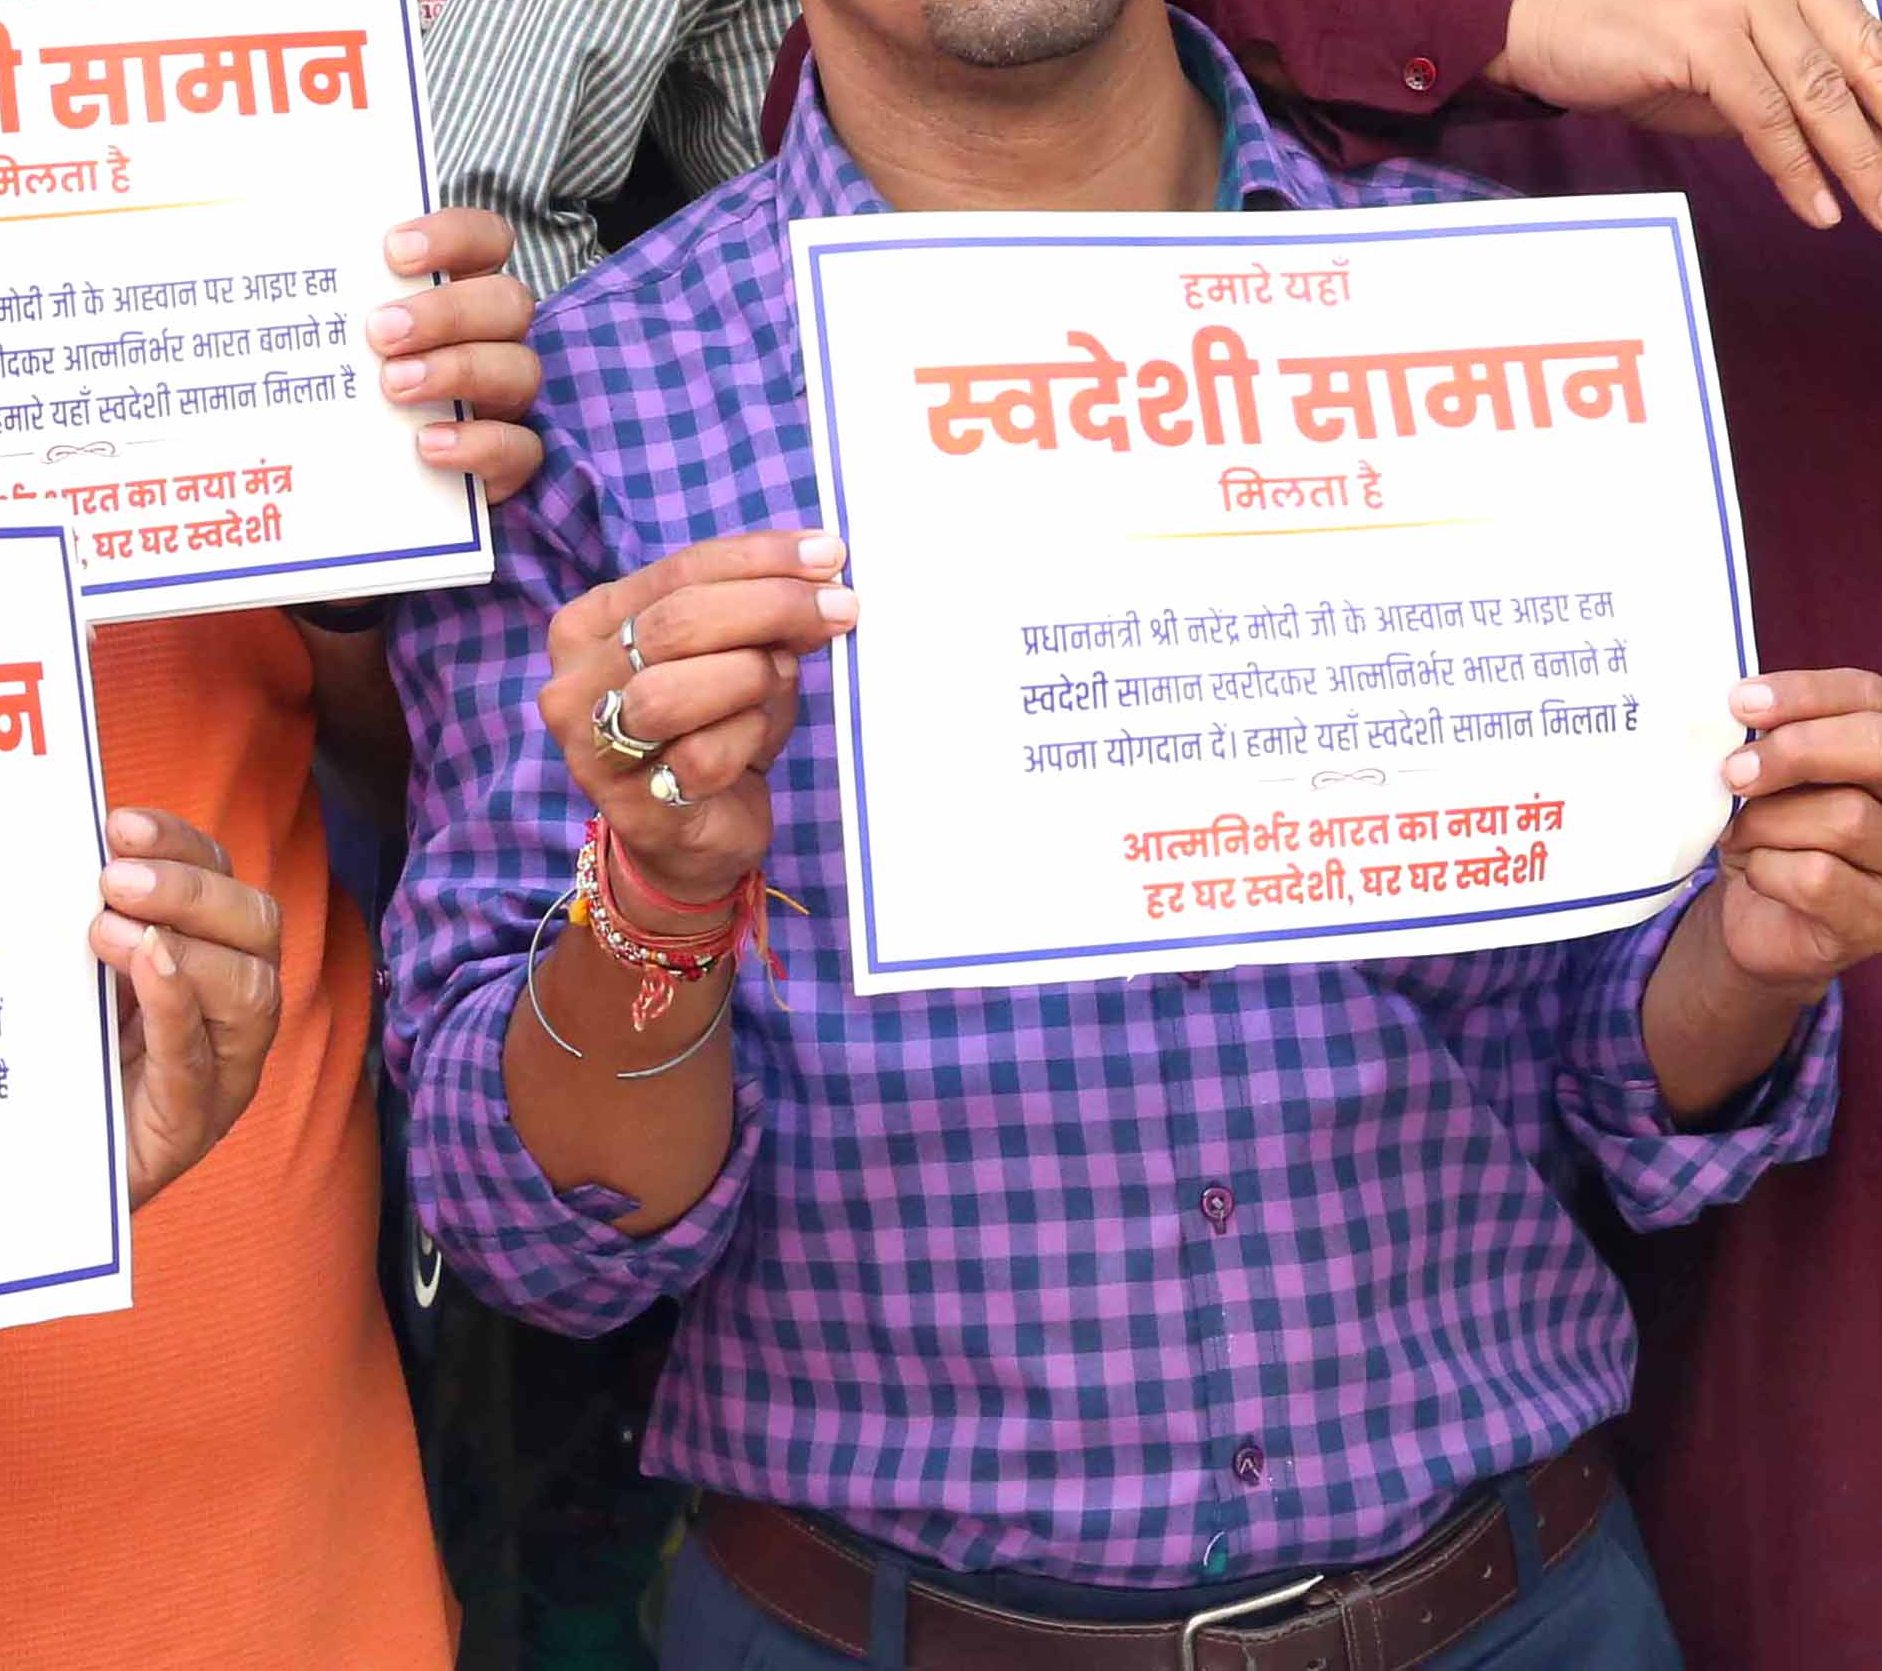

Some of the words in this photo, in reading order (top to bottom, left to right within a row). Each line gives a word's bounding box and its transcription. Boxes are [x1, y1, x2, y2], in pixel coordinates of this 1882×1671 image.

[38, 29, 369, 130] सामान
[106, 144, 131, 194] है
[1179, 262, 1273, 310] हमारे
[1280, 259, 1351, 307] यहाँ
[913, 324, 1263, 456] स्वदेशी
[1276, 338, 1648, 443] सामान
[1217, 466, 1349, 512] मिलता
[1356, 460, 1384, 510] है
[1122, 810, 1301, 863] आत्मनिर्भर
[1308, 813, 1391, 849] भारत
[1394, 809, 1440, 843] का
[1443, 804, 1511, 839] नया
[1513, 792, 1566, 833] मंत्र
